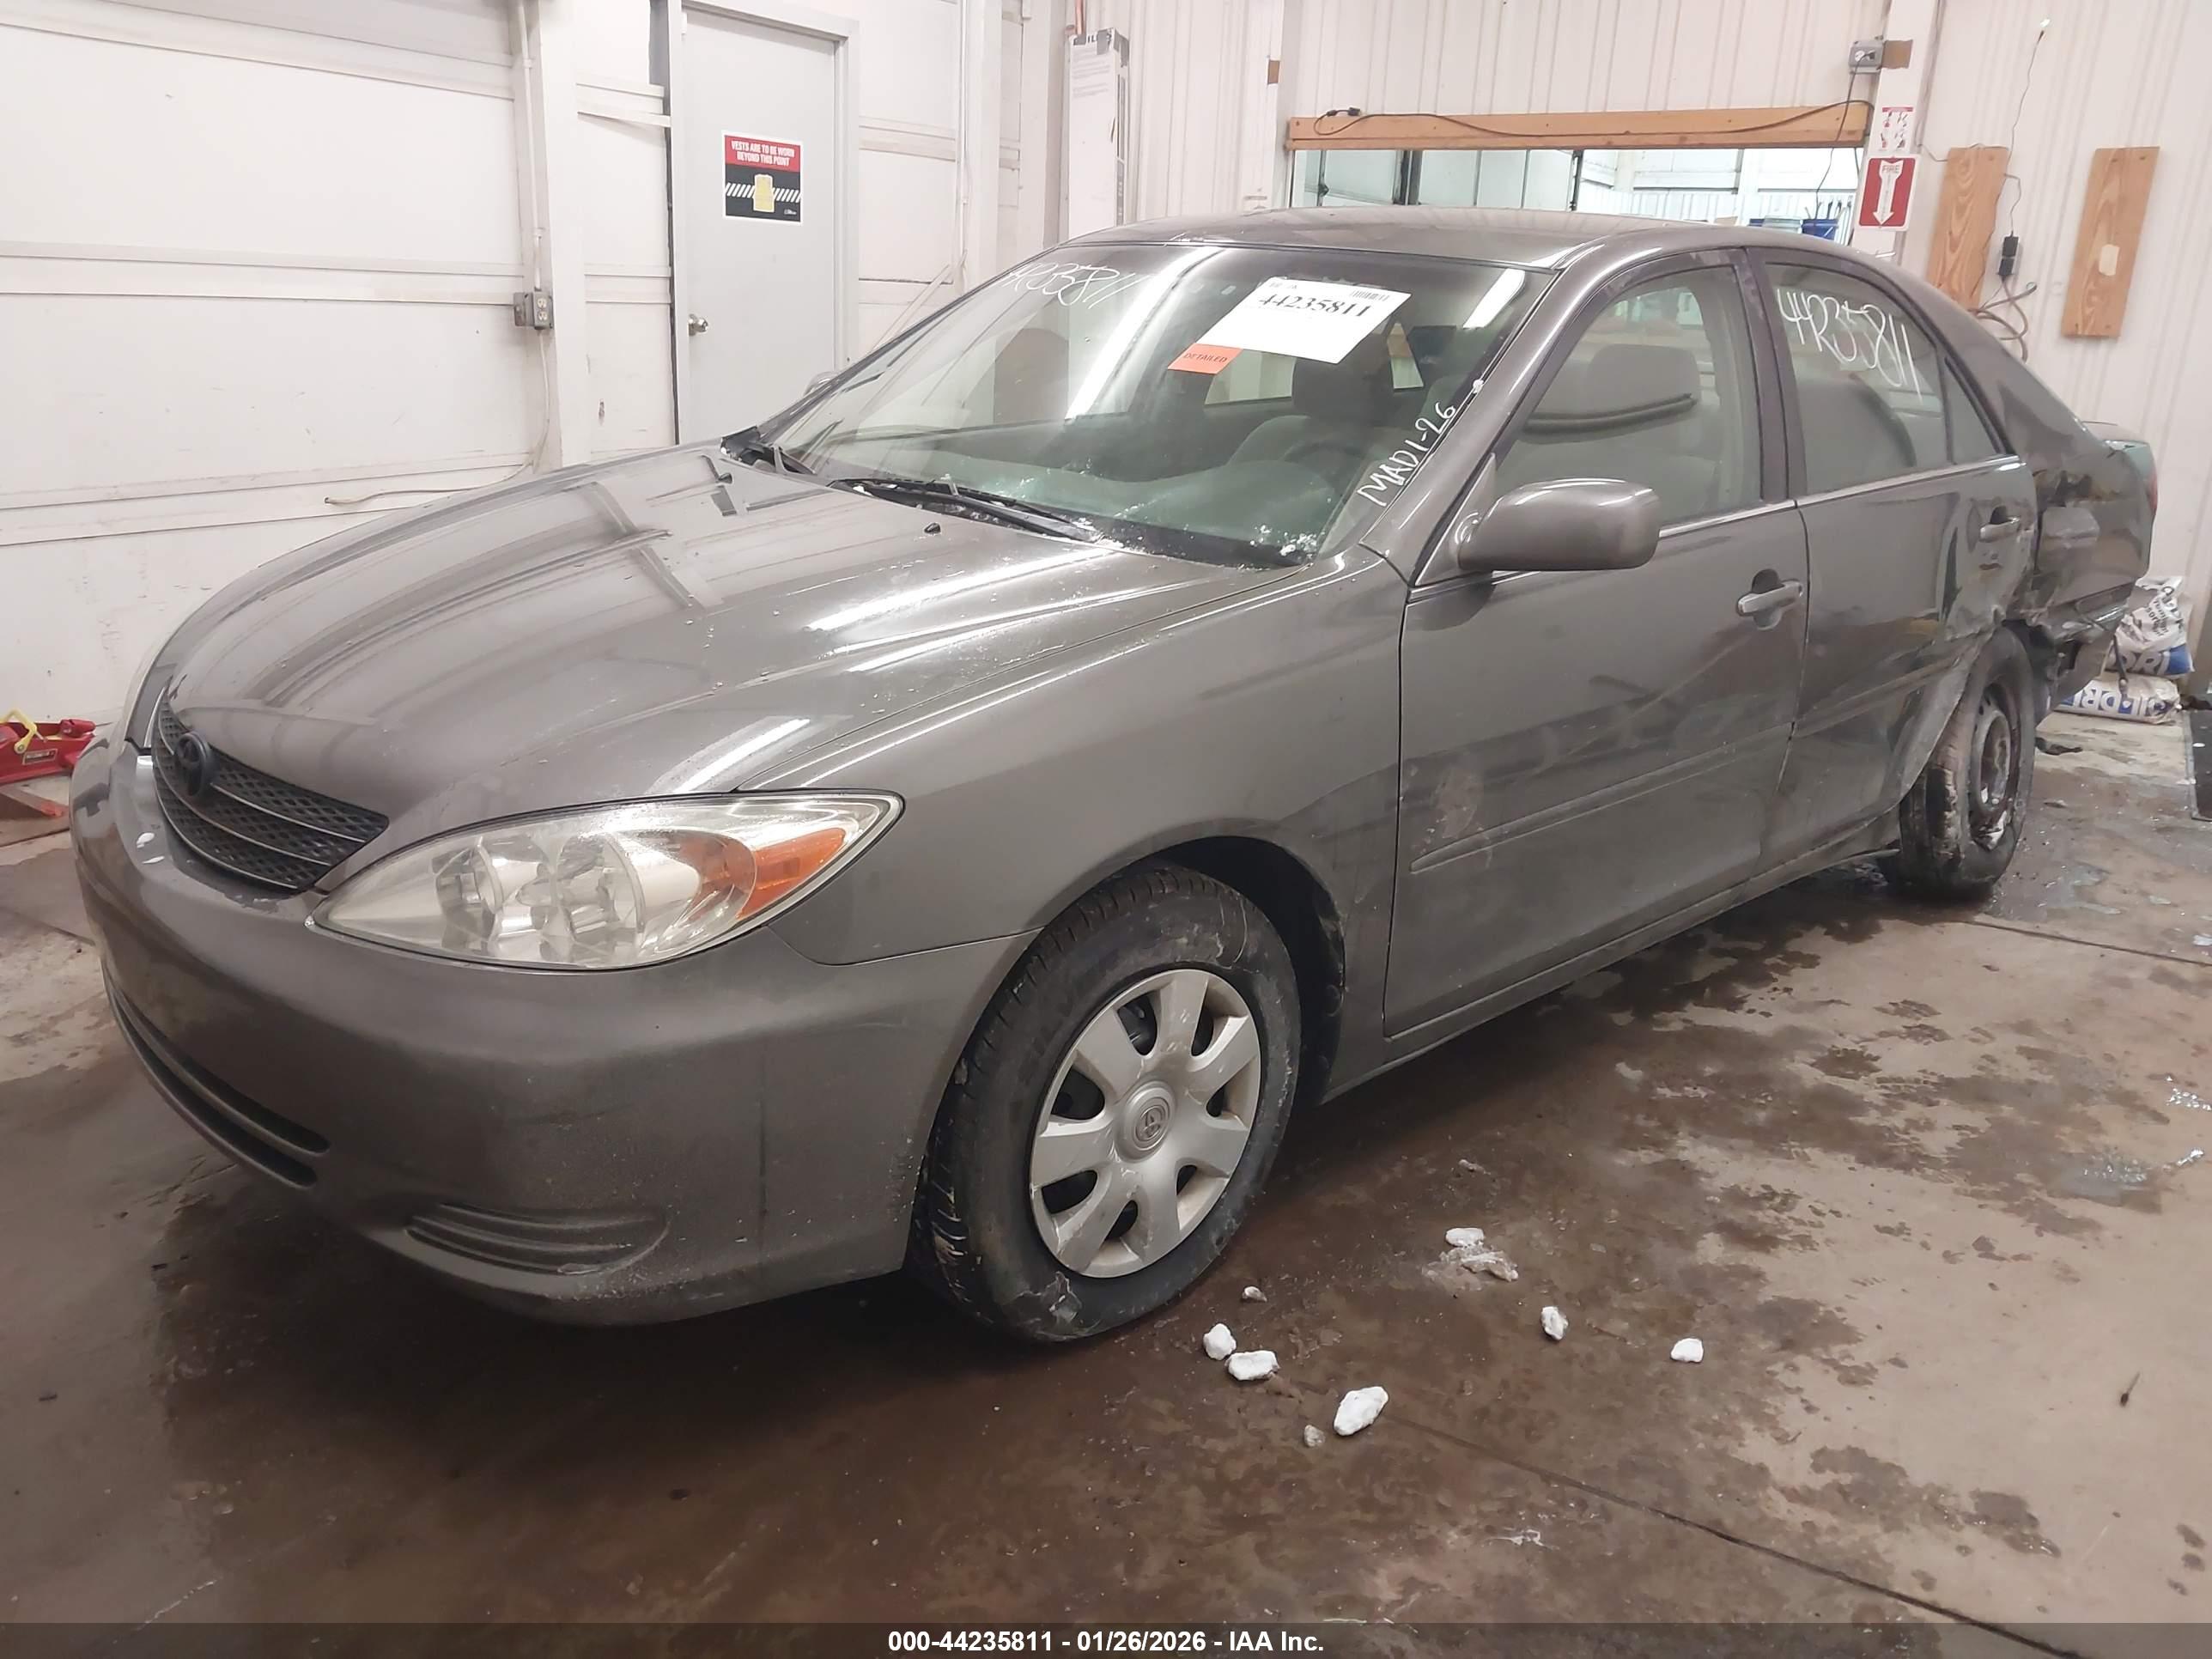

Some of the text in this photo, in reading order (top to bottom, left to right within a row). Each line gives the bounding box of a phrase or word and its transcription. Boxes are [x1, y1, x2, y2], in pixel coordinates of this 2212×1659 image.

[731, 140, 795, 158] VESTS ARE TO BE WORN
[736, 151, 791, 167] BEYOND THIS POINT
[1881, 164, 1900, 173] FIRE
[1259, 294, 1372, 318] 44235811
[1183, 352, 1229, 363] DETAILED
